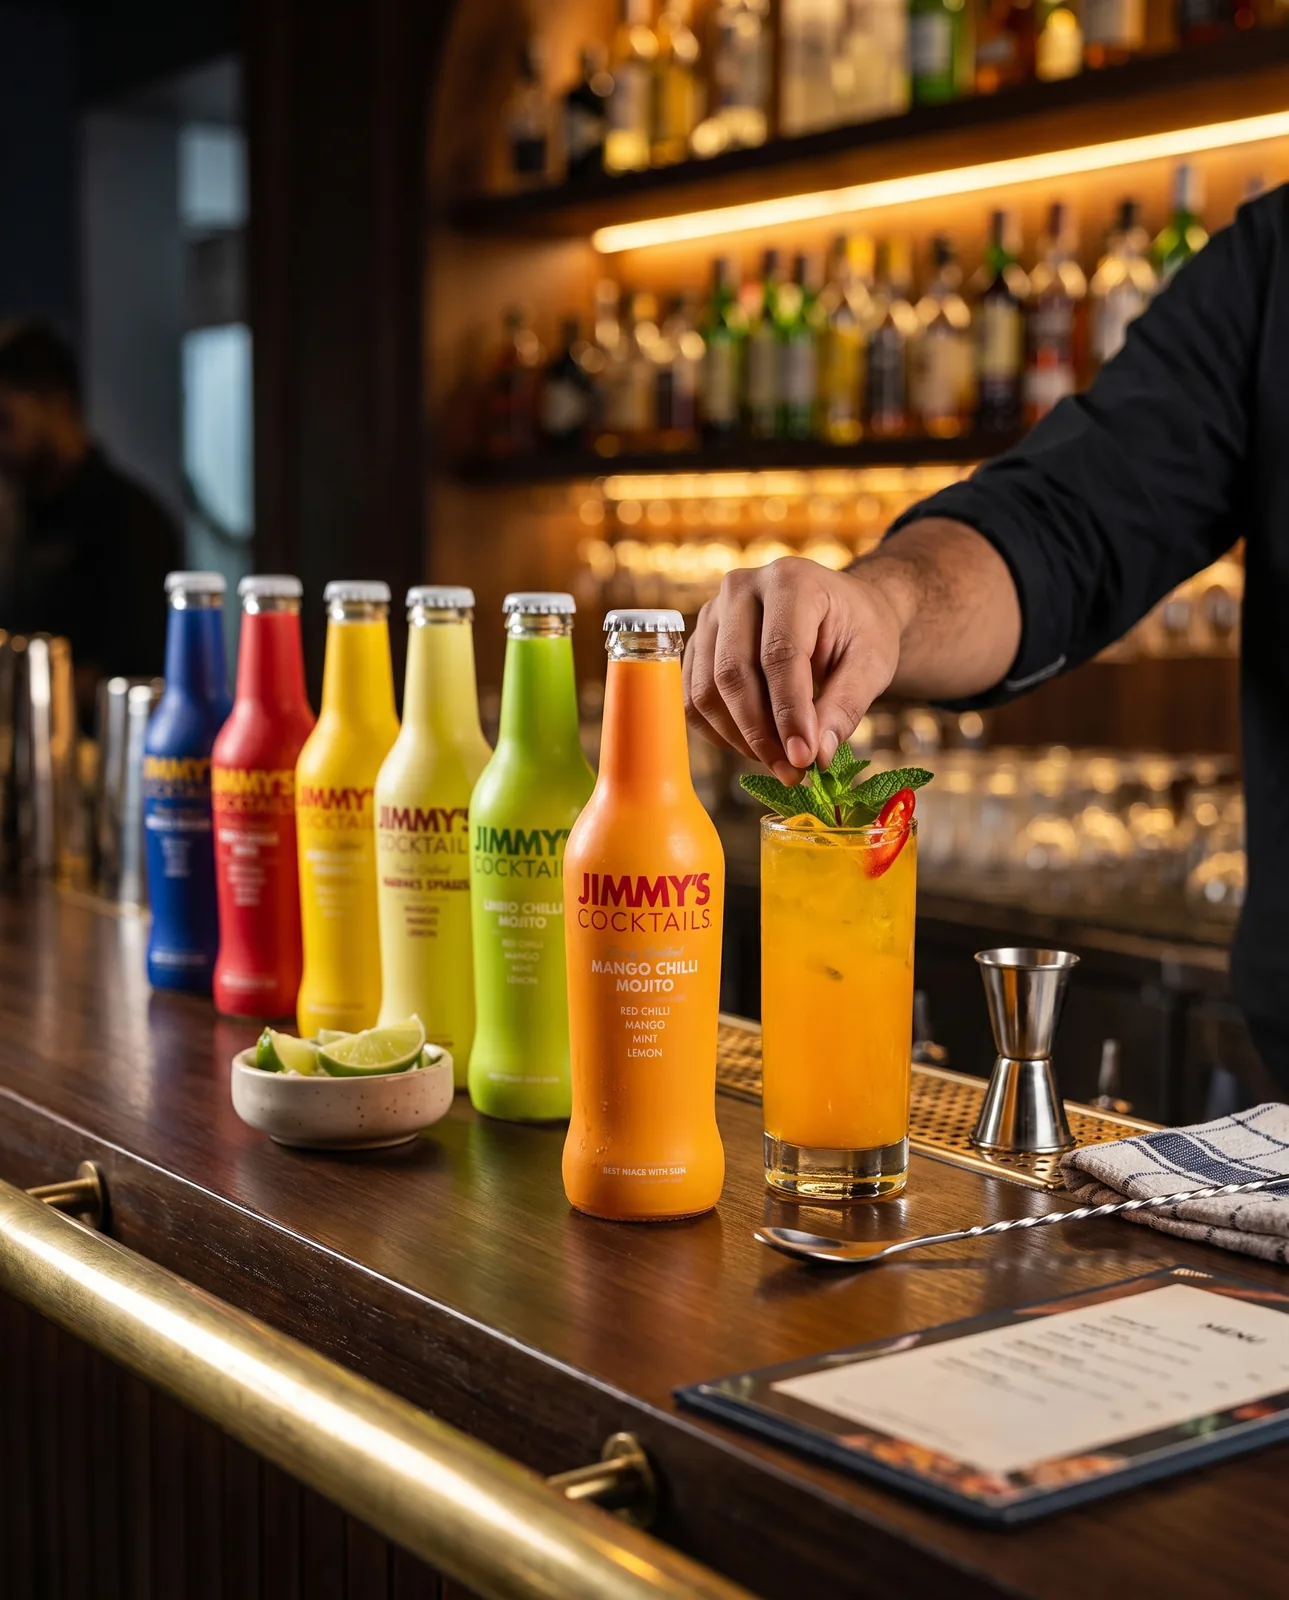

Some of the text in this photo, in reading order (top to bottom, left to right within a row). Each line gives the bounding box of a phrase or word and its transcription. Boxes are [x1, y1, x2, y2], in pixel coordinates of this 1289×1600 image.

[475, 825, 570, 856] JIMMY'
[475, 855, 563, 878] COCKTAI
[578, 872, 711, 908] JIMMY'S
[591, 960, 698, 976] MANGO CHILLI
[616, 978, 674, 993] MOJITO
[620, 1006, 670, 1016] RED CHILLI
[625, 1020, 665, 1030] MANGO
[632, 1034, 658, 1044] MINT
[627, 1048, 662, 1058] LEMON
[603, 1166, 620, 1175] BEST
[648, 1168, 668, 1176] WITH
